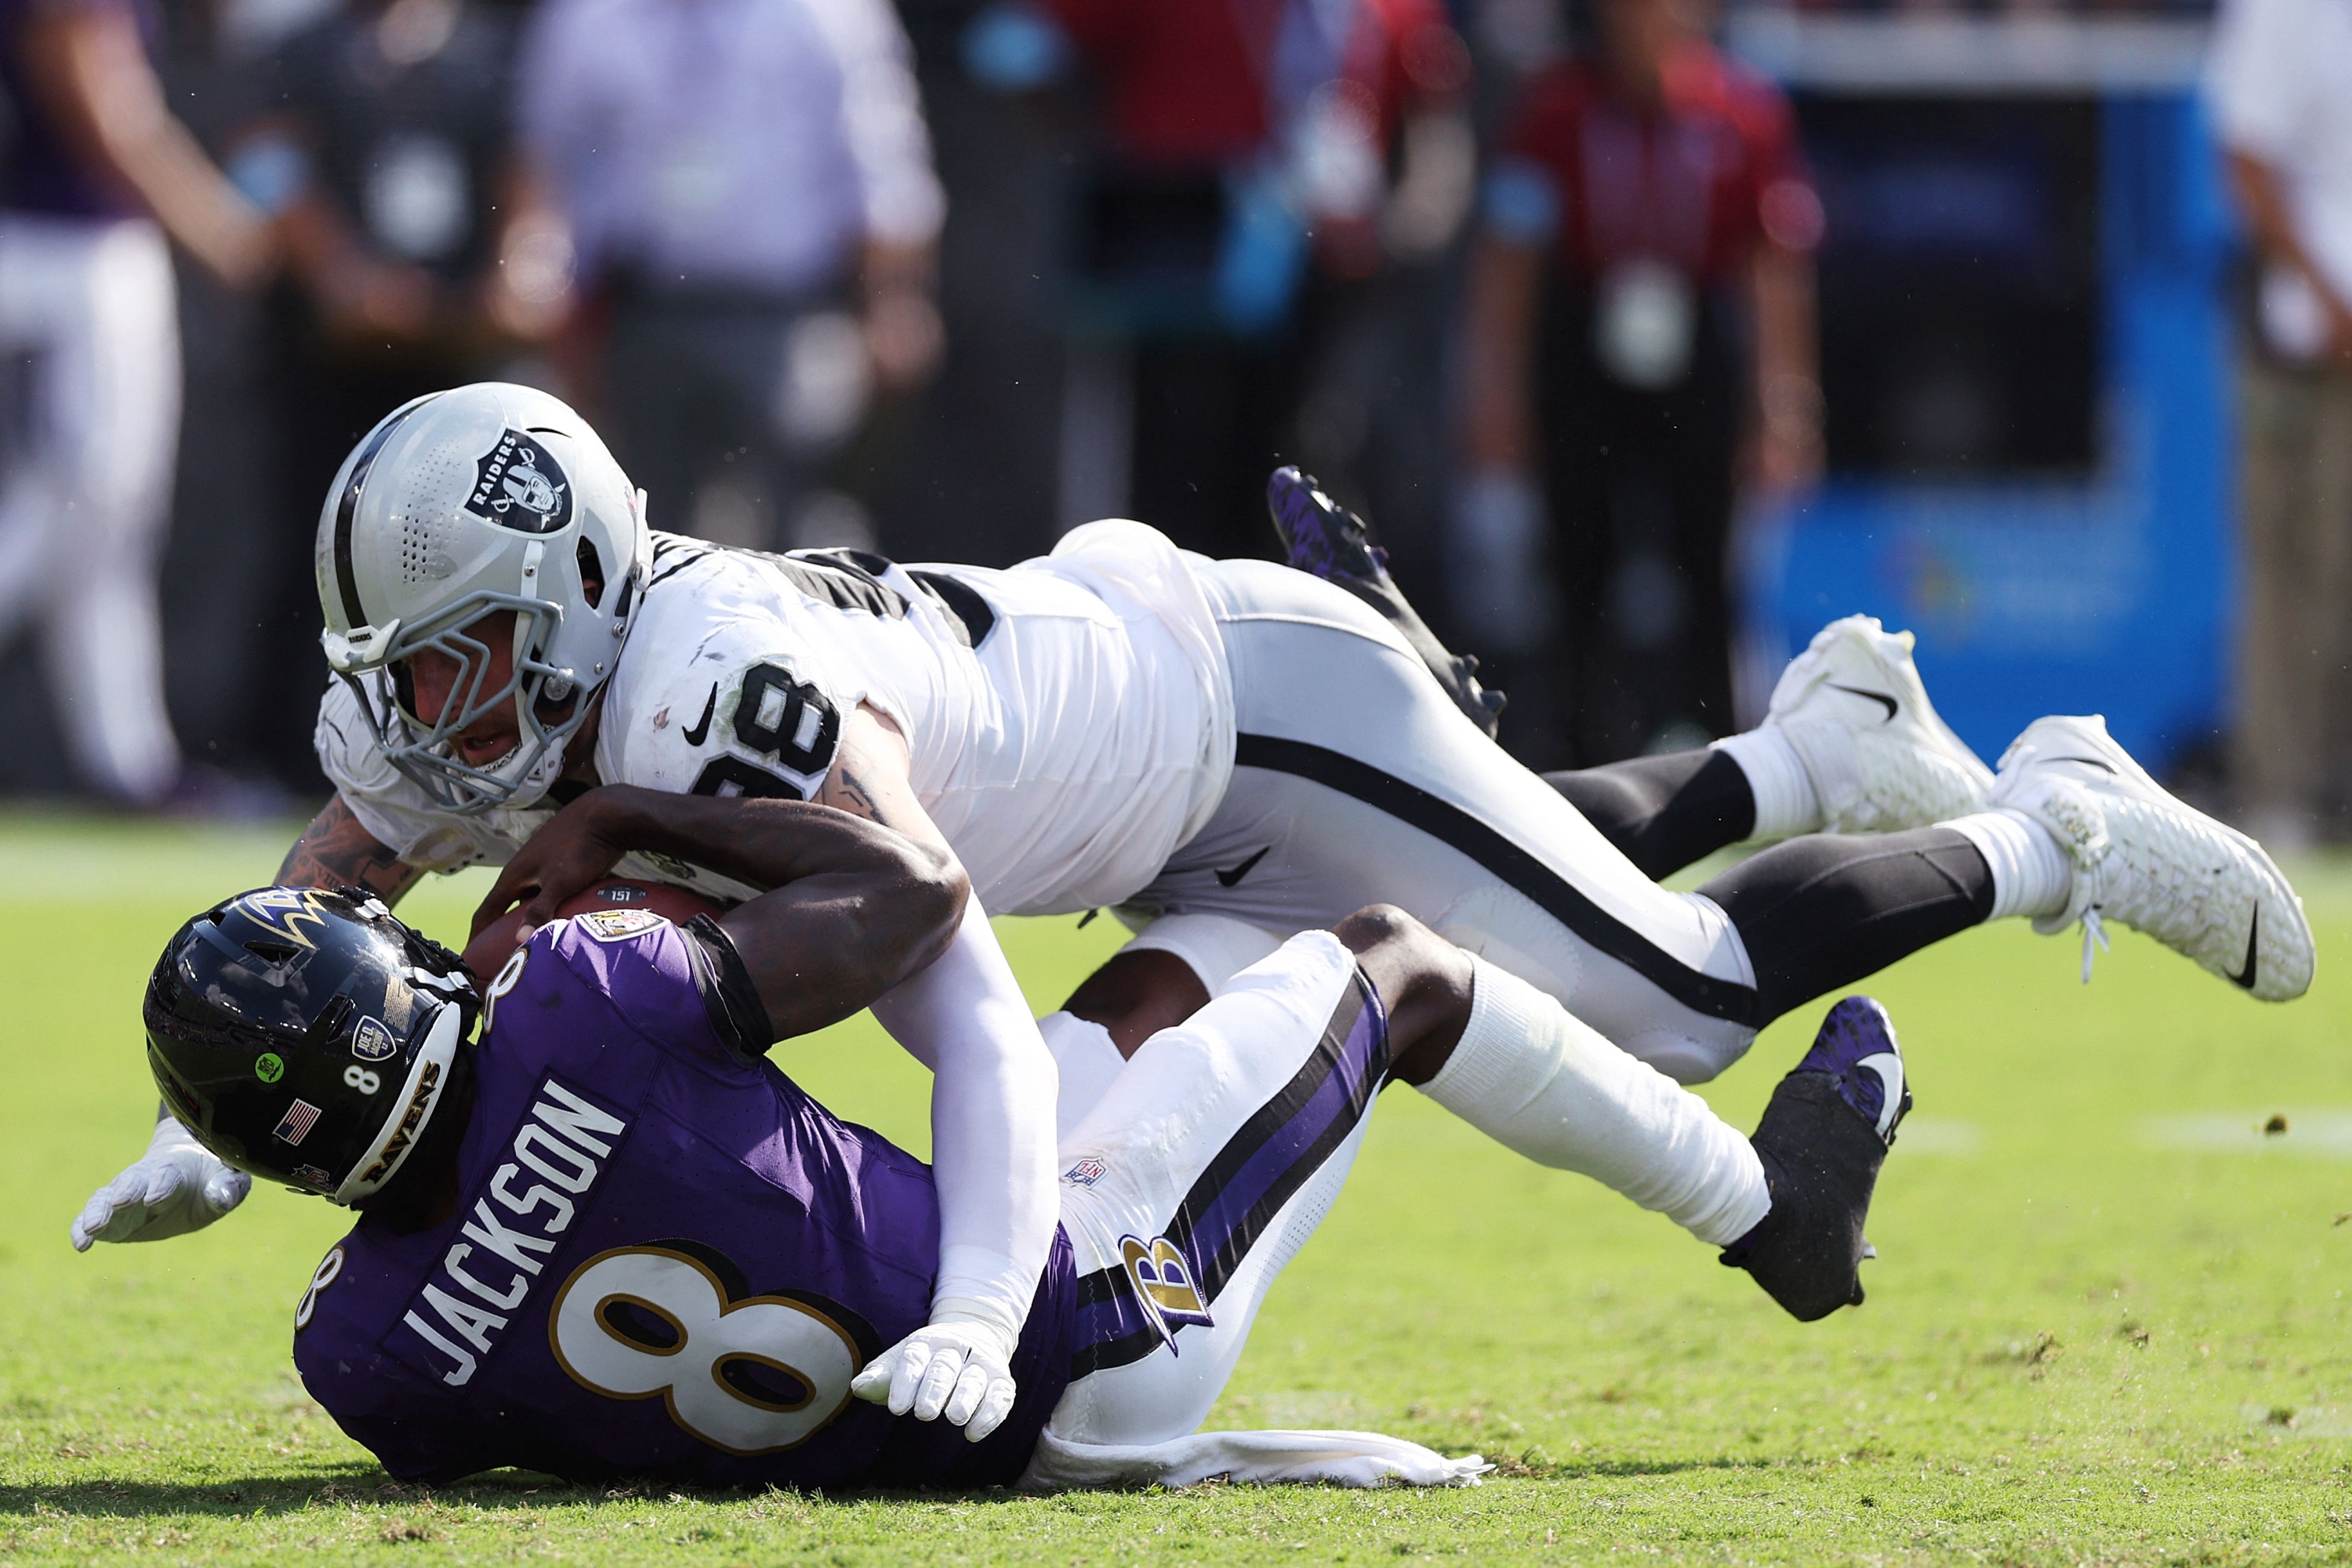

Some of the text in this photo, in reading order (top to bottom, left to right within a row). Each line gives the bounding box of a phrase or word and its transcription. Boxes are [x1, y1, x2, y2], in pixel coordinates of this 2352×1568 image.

[472, 435, 517, 506] RAIDERS
[612, 891, 631, 902] 151
[482, 944, 531, 1034] 8
[343, 1065, 380, 1095] 8
[357, 1033, 372, 1052] JOE
[370, 1029, 385, 1057] JACOBY
[360, 1060, 441, 1185] RAVENS
[1078, 1162, 1103, 1178] NFL
[403, 1079, 626, 1387] JACKSON
[295, 1244, 346, 1331] 8
[1118, 1233, 1214, 1359] B
[549, 1240, 869, 1457] 8
